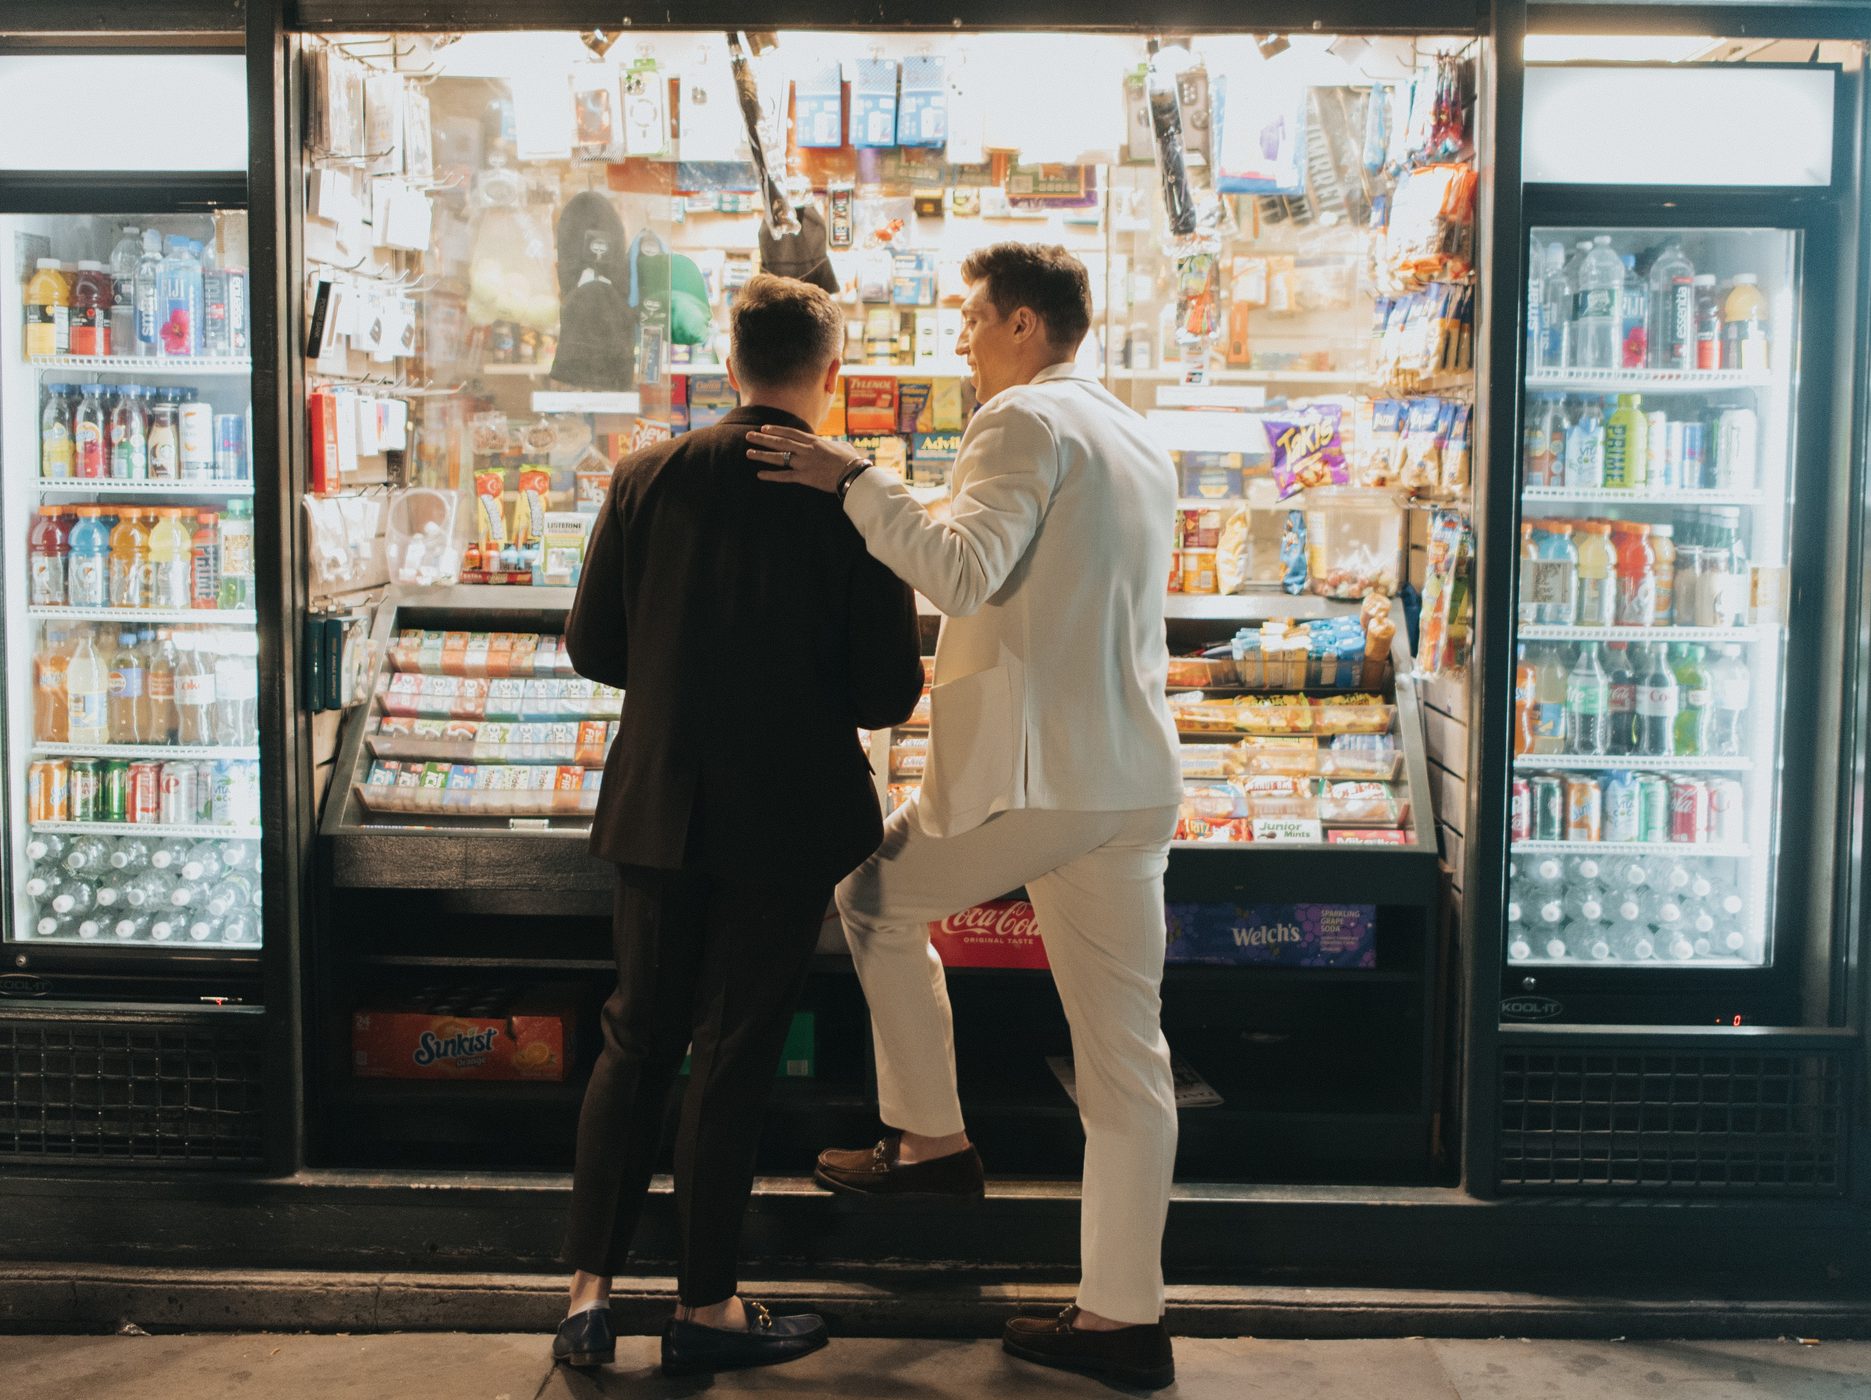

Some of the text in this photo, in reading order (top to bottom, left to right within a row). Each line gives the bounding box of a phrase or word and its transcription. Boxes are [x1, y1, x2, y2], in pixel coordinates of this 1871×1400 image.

[1676, 286, 1689, 339] essentia
[851, 380, 892, 389] TYLENOL
[1607, 423, 1627, 482] PRIME
[1259, 822, 1302, 831] Junior
[1284, 831, 1310, 839] Mints
[1320, 910, 1361, 918] SPARKLING
[1320, 917, 1344, 925] GRAPE
[1231, 923, 1300, 946] Welch's
[413, 1027, 499, 1067] Sunkist
